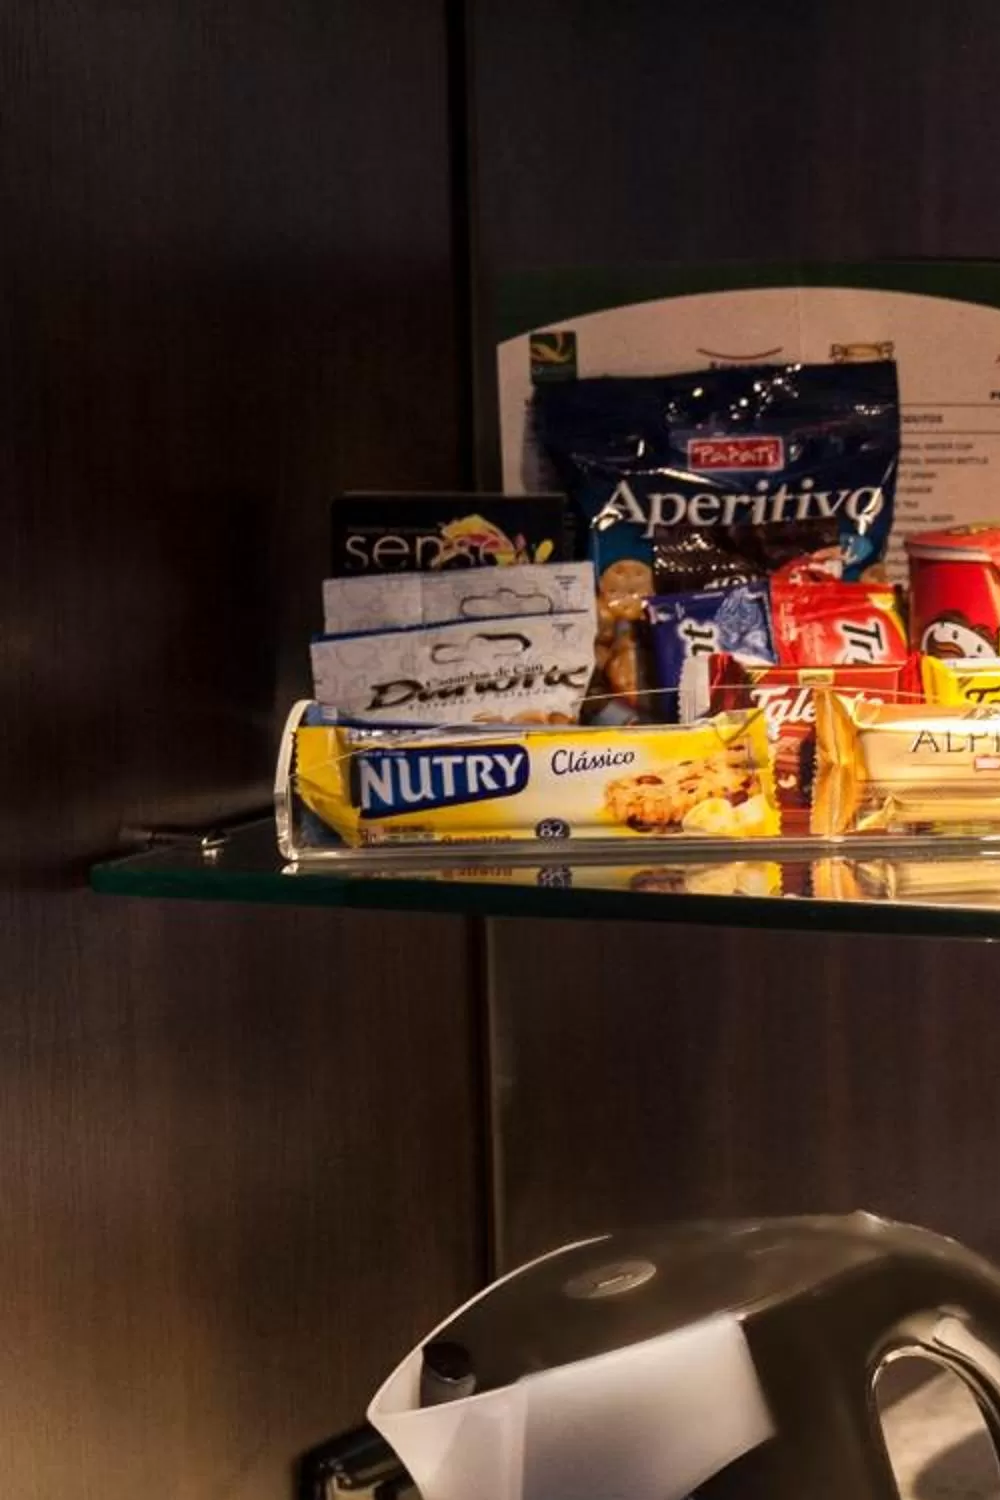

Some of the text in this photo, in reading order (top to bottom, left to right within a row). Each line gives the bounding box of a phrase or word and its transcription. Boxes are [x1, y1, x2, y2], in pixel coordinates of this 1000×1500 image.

[596, 478, 885, 537] Aperitivo
[358, 753, 525, 810] NUTRY
[551, 748, 636, 776] Clássico
